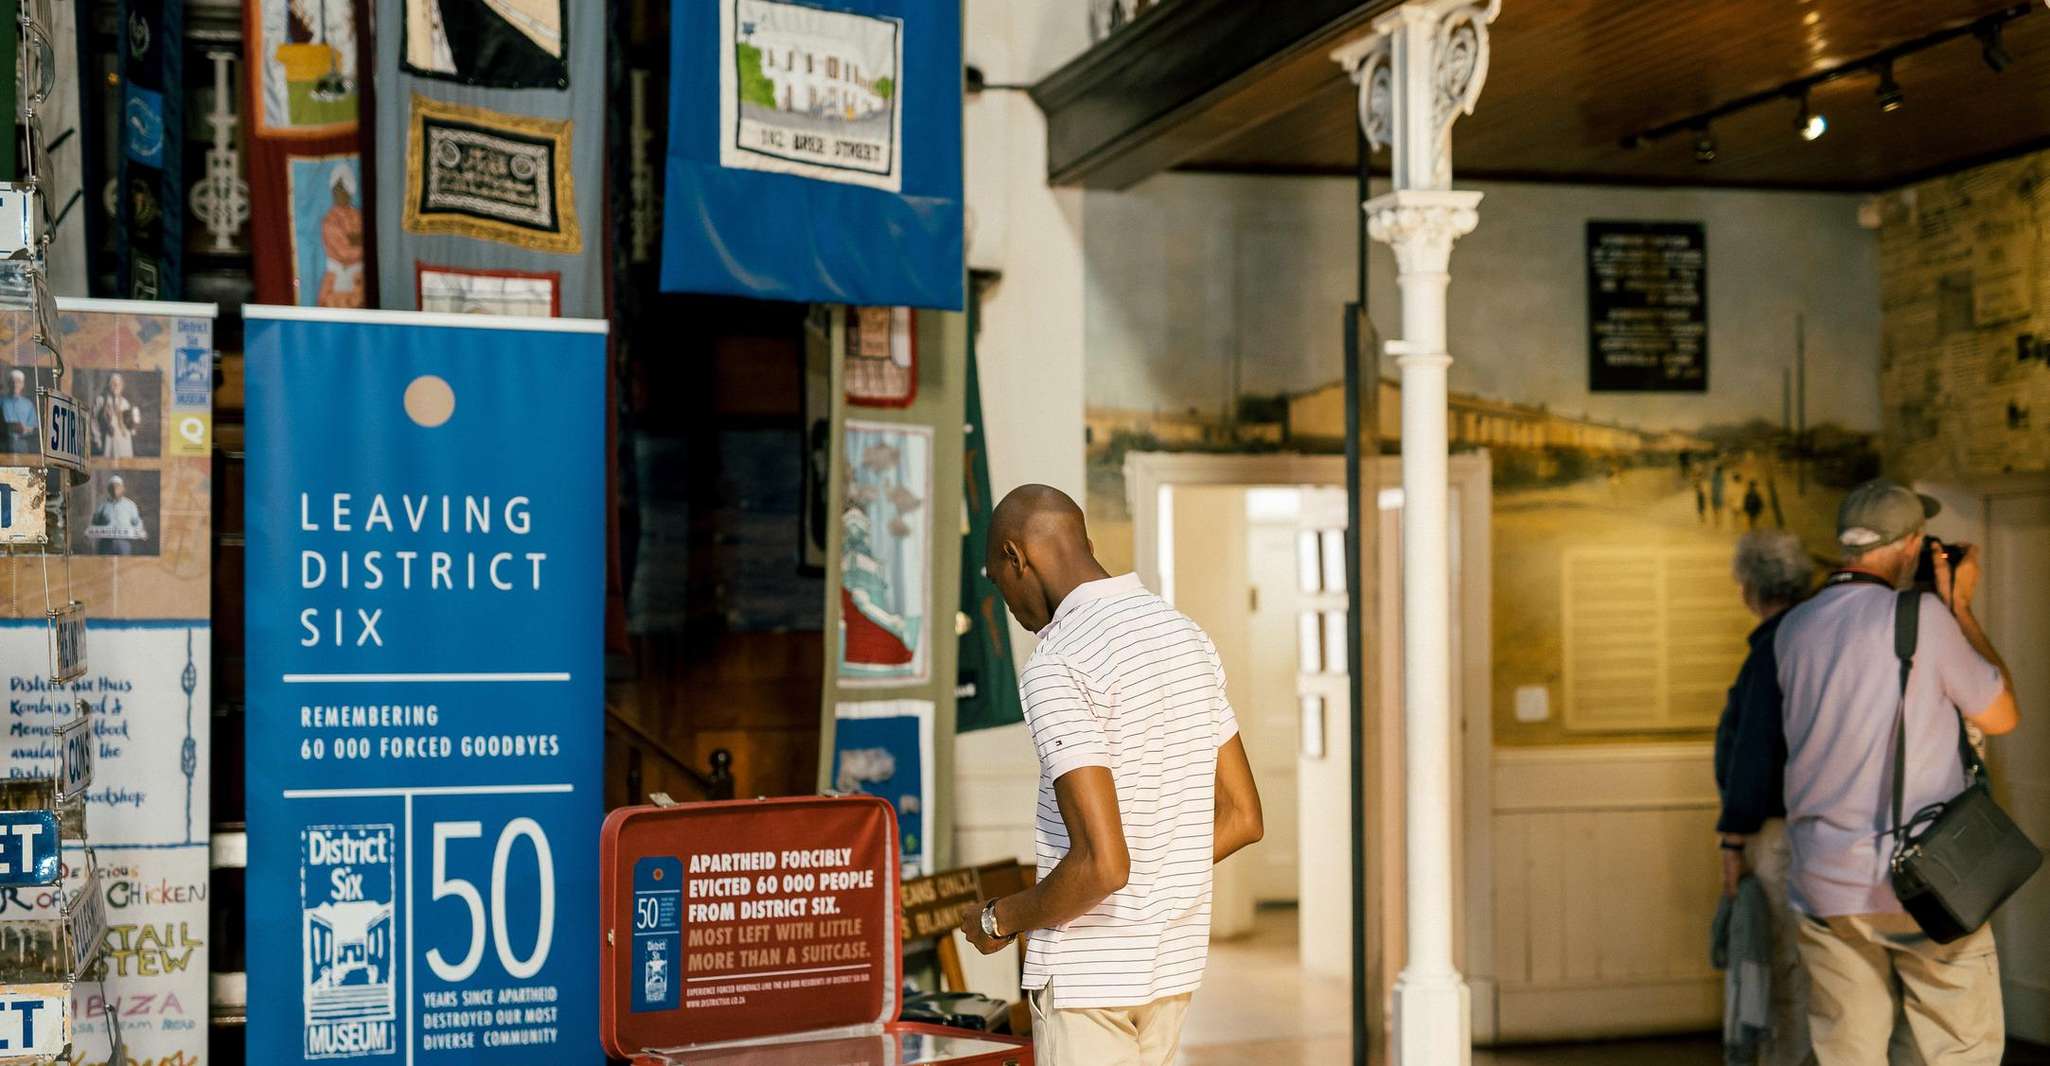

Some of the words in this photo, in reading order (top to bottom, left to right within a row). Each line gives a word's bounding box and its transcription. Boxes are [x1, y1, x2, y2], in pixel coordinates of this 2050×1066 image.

[301, 491, 531, 534] LEAVING
[301, 550, 547, 590] DISTRICT
[300, 607, 383, 647] SIX
[301, 704, 439, 728] REMEMBERING
[300, 738, 325, 760] 60
[333, 737, 371, 759] 000
[379, 736, 451, 758] FORCED
[461, 734, 560, 758] GOODBYES
[308, 829, 389, 867] District
[688, 852, 776, 874] APARTHEID
[780, 848, 853, 870] FORCIBLY
[330, 866, 364, 901] Six
[688, 876, 751, 899] EVICTED
[756, 875, 778, 895] 60
[782, 873, 816, 893] 000
[819, 869, 875, 892] PEOPLE
[424, 816, 556, 983] 50
[636, 896, 659, 930] 50
[688, 901, 736, 923] FROM
[740, 897, 808, 920] DISTRICT
[811, 896, 841, 916] SIX.
[688, 926, 733, 948] MOST
[737, 923, 772, 944] LEFT
[775, 920, 815, 941] WITH
[819, 917, 863, 937] LITTLE
[687, 950, 735, 972] MORE
[739, 947, 782, 968] THAN
[785, 946, 797, 965] A
[800, 940, 872, 964] SUITCASE.
[423, 990, 459, 1009] YEARS
[462, 988, 494, 1007] SINCE
[497, 985, 558, 1005] APARTHEID
[423, 1009, 494, 1030] DESTROYED
[495, 1008, 522, 1026] OUR
[525, 1006, 558, 1023] MOST
[308, 1021, 388, 1054] MUSEUM
[423, 1032, 475, 1051] DIVERSE
[482, 1027, 558, 1048] COMMUNITY
